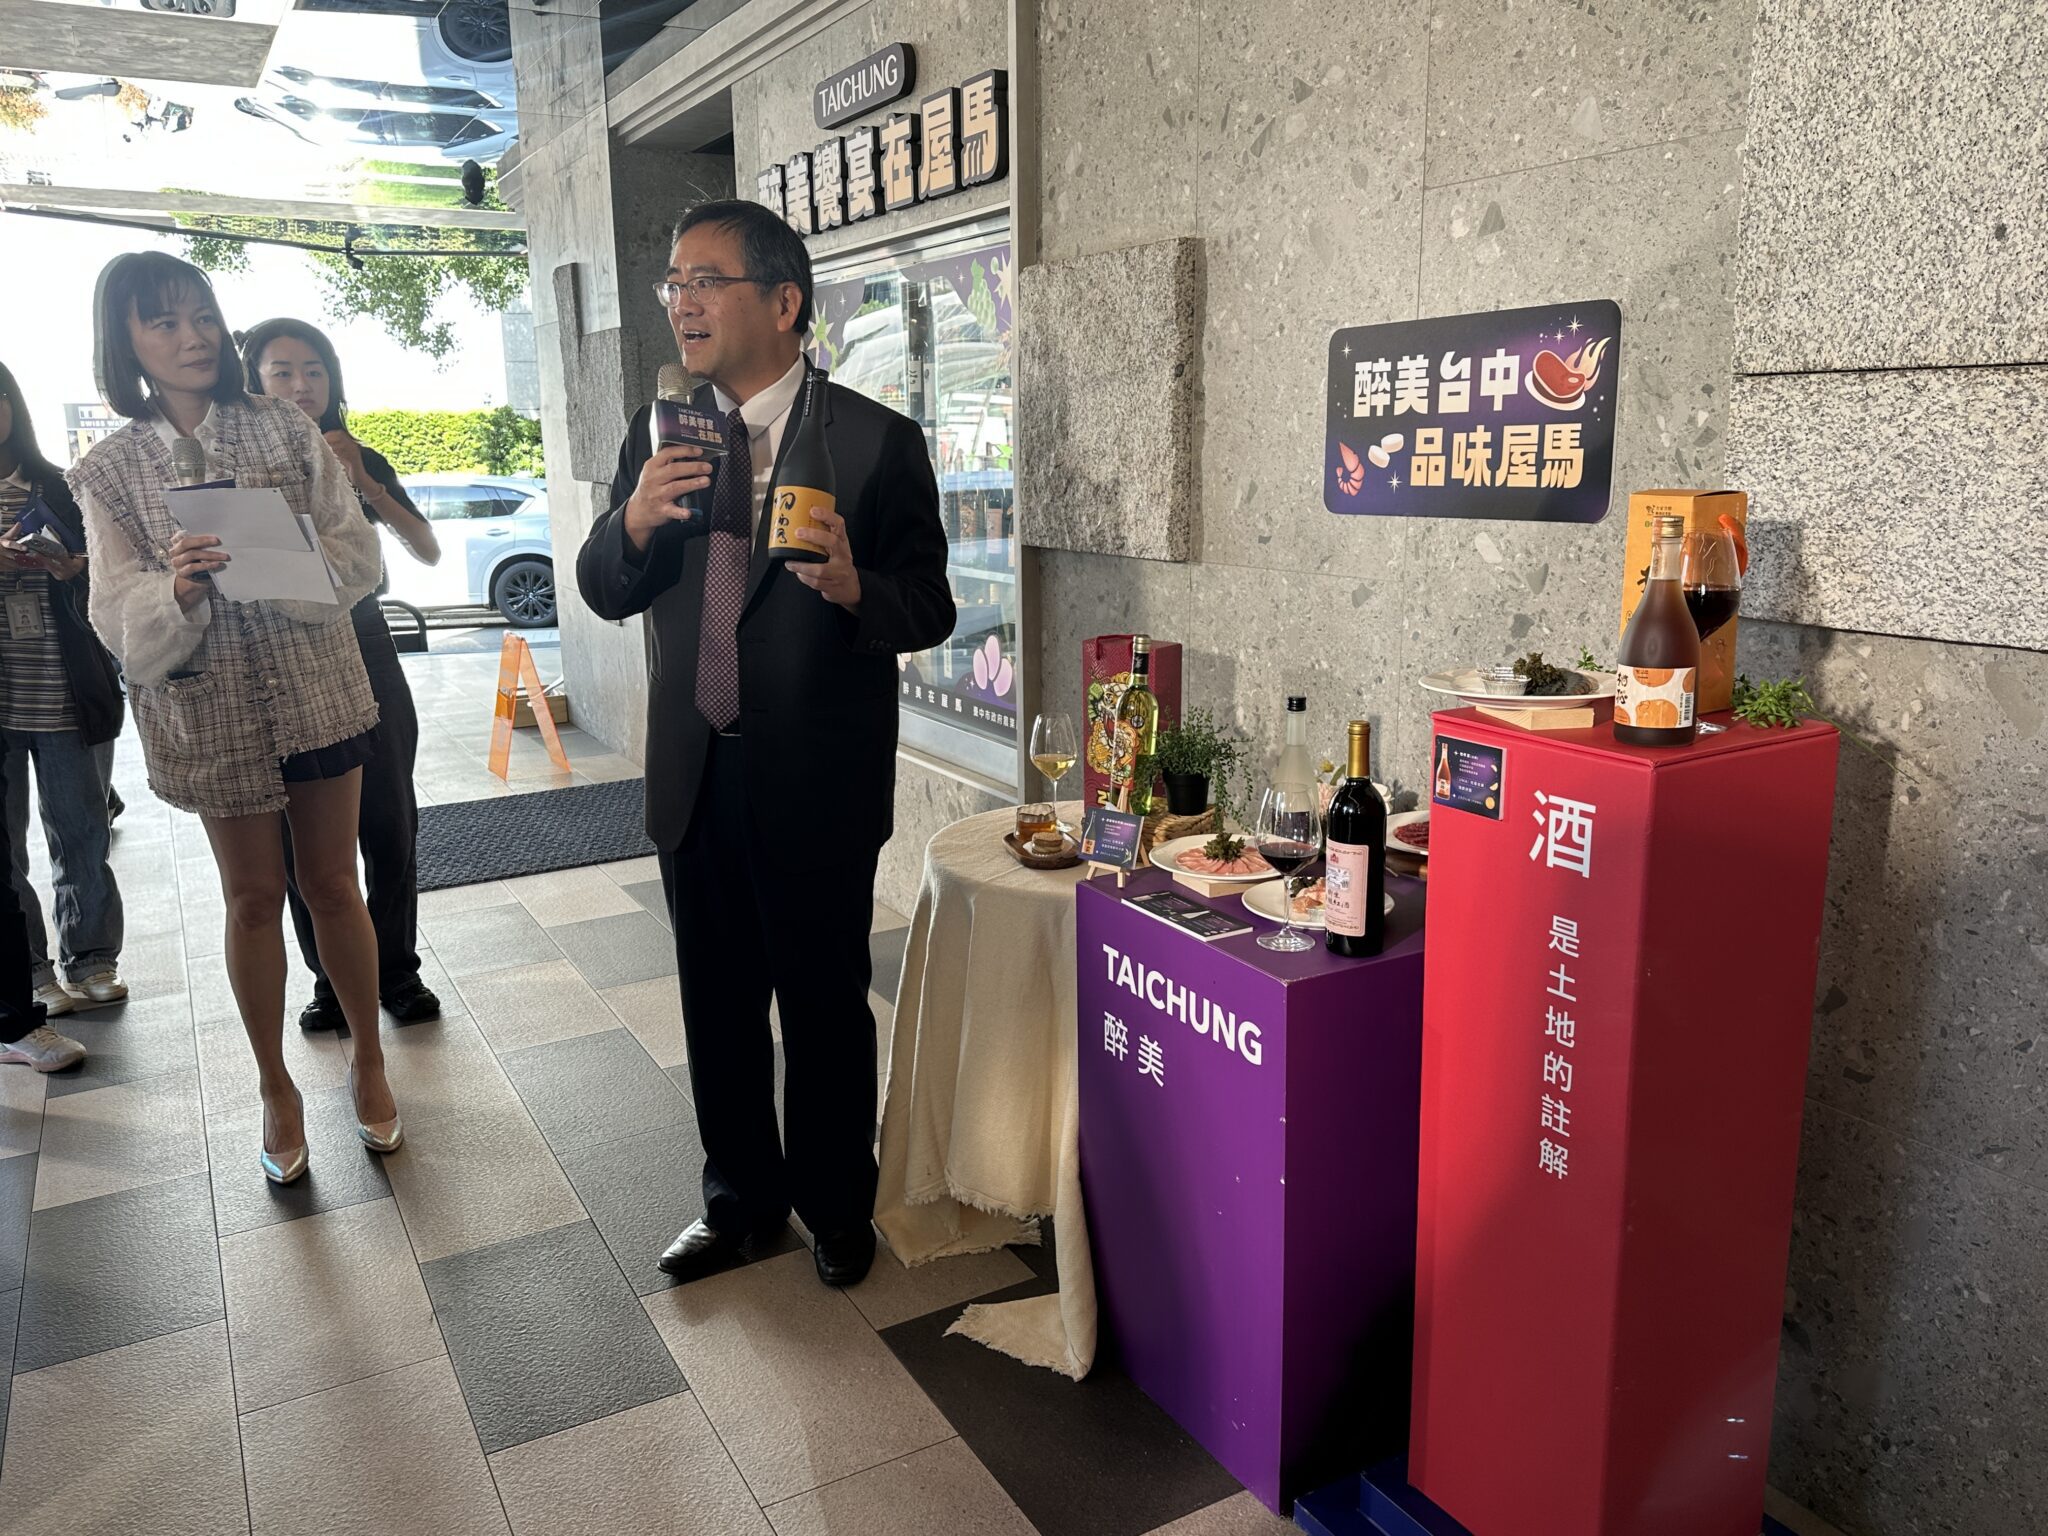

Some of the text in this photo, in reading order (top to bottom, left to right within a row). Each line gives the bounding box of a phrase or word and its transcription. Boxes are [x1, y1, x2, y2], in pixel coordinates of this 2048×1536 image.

[818, 54, 898, 117] TAICHUNG
[1353, 348, 1521, 418] 醉美台中
[1410, 423, 1584, 489] 品味屋馬
[1529, 789, 1597, 878] 酒
[1102, 943, 1262, 1066] TAICHUNG
[1104, 1011, 1164, 1087] 醉美
[1538, 915, 1580, 1180] 是土地的註解
